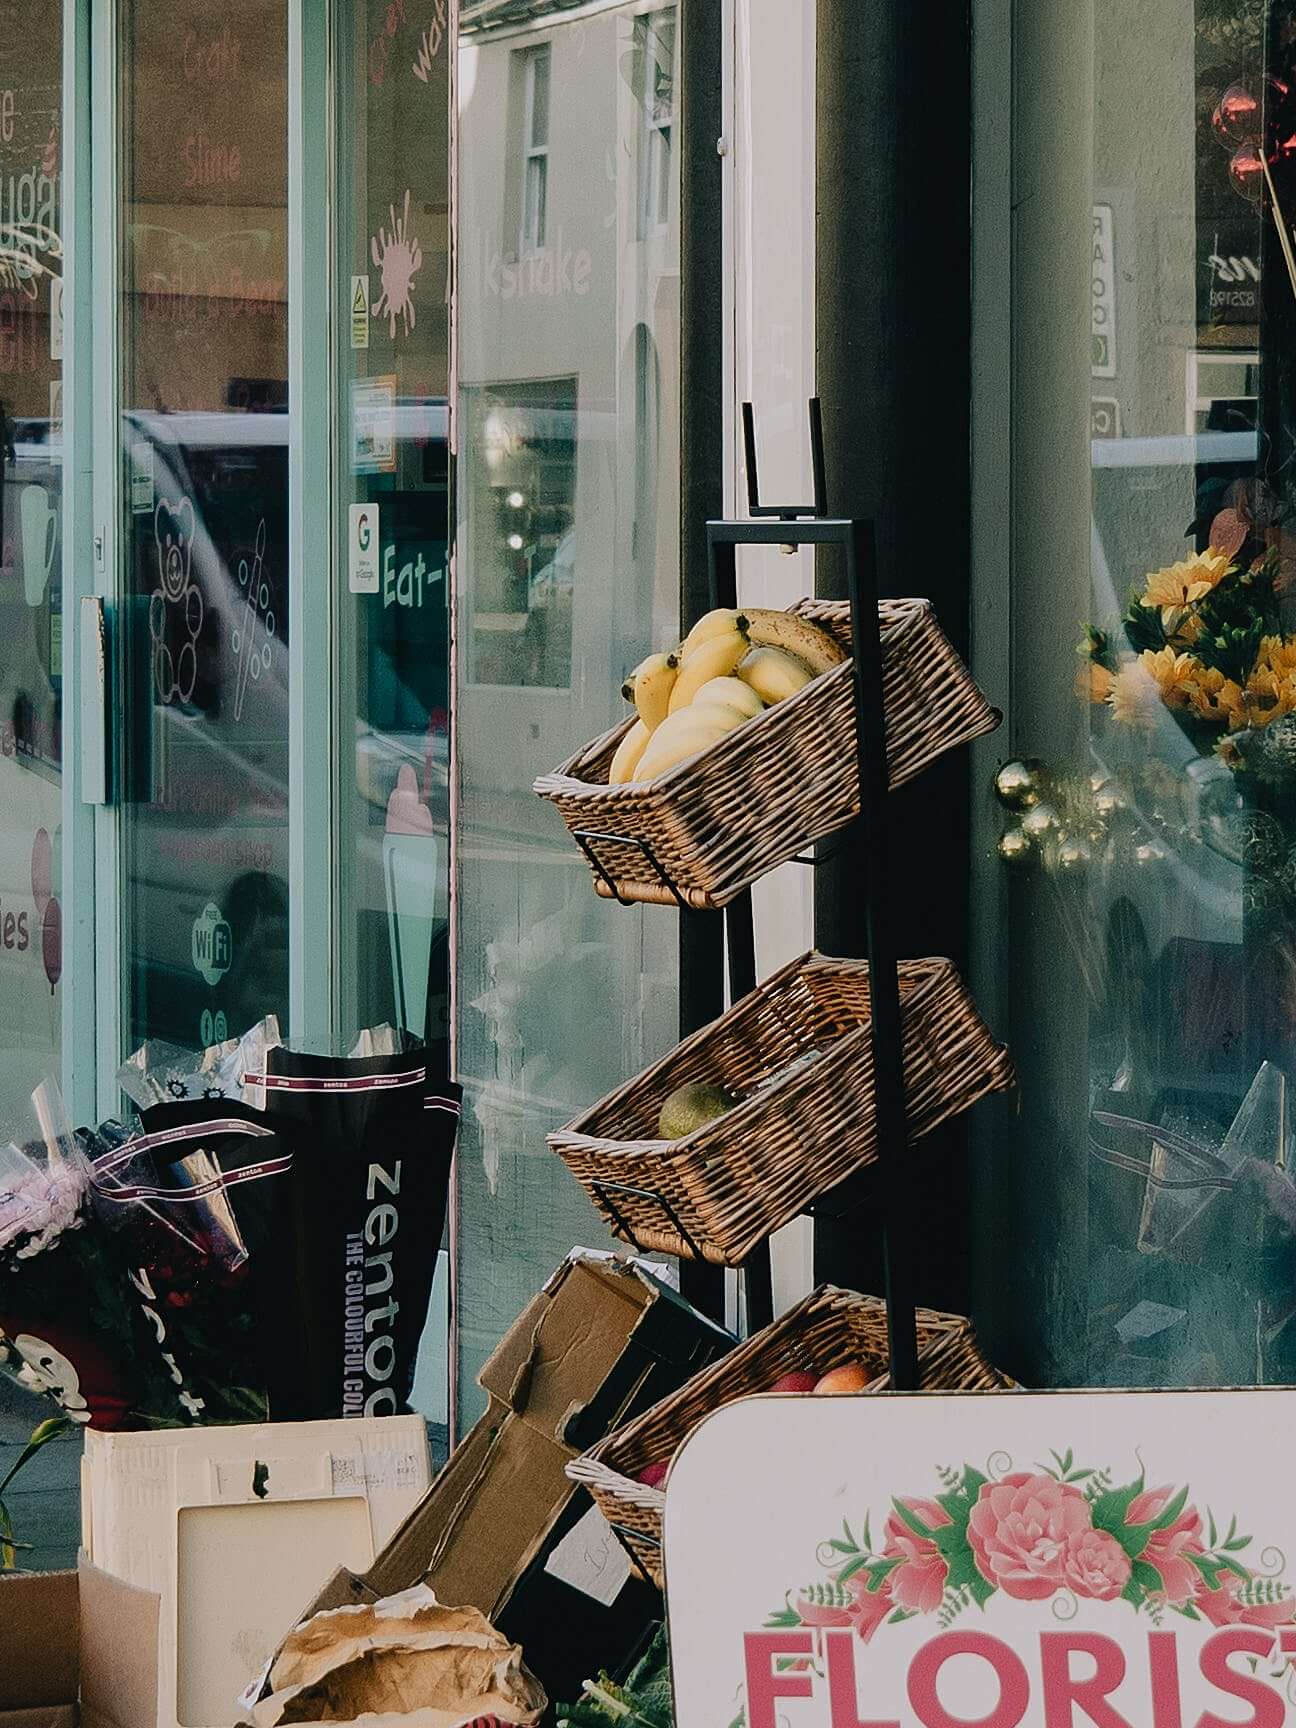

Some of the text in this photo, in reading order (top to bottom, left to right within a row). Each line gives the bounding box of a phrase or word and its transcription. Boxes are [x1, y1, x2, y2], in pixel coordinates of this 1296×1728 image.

[184, 129, 242, 187] Slime
[343, 1229, 365, 1270] THE
[343, 1272, 365, 1378] COLOURFUL
